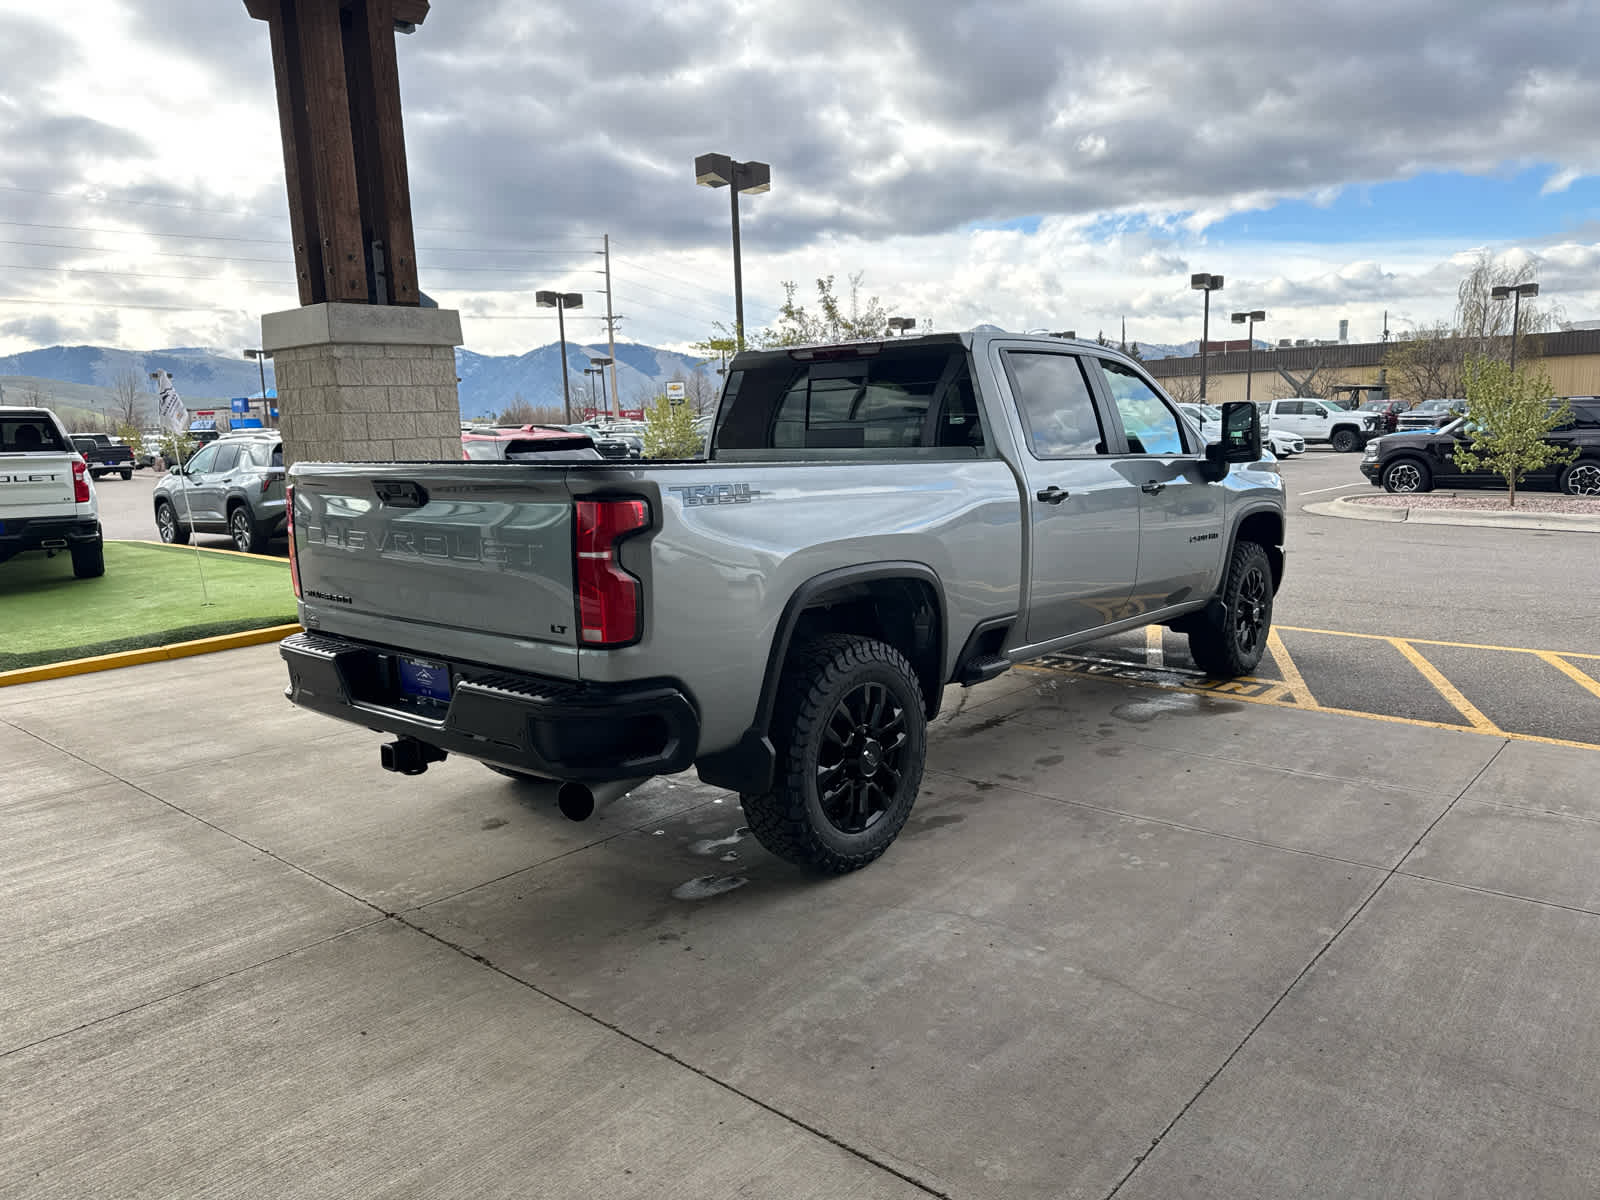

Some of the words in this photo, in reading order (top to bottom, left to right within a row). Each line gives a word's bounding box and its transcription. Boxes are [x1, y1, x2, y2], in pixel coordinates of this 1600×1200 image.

[682, 496, 751, 507] BOSS
[306, 525, 543, 566] CHEVROLET
[550, 623, 567, 635] LT
